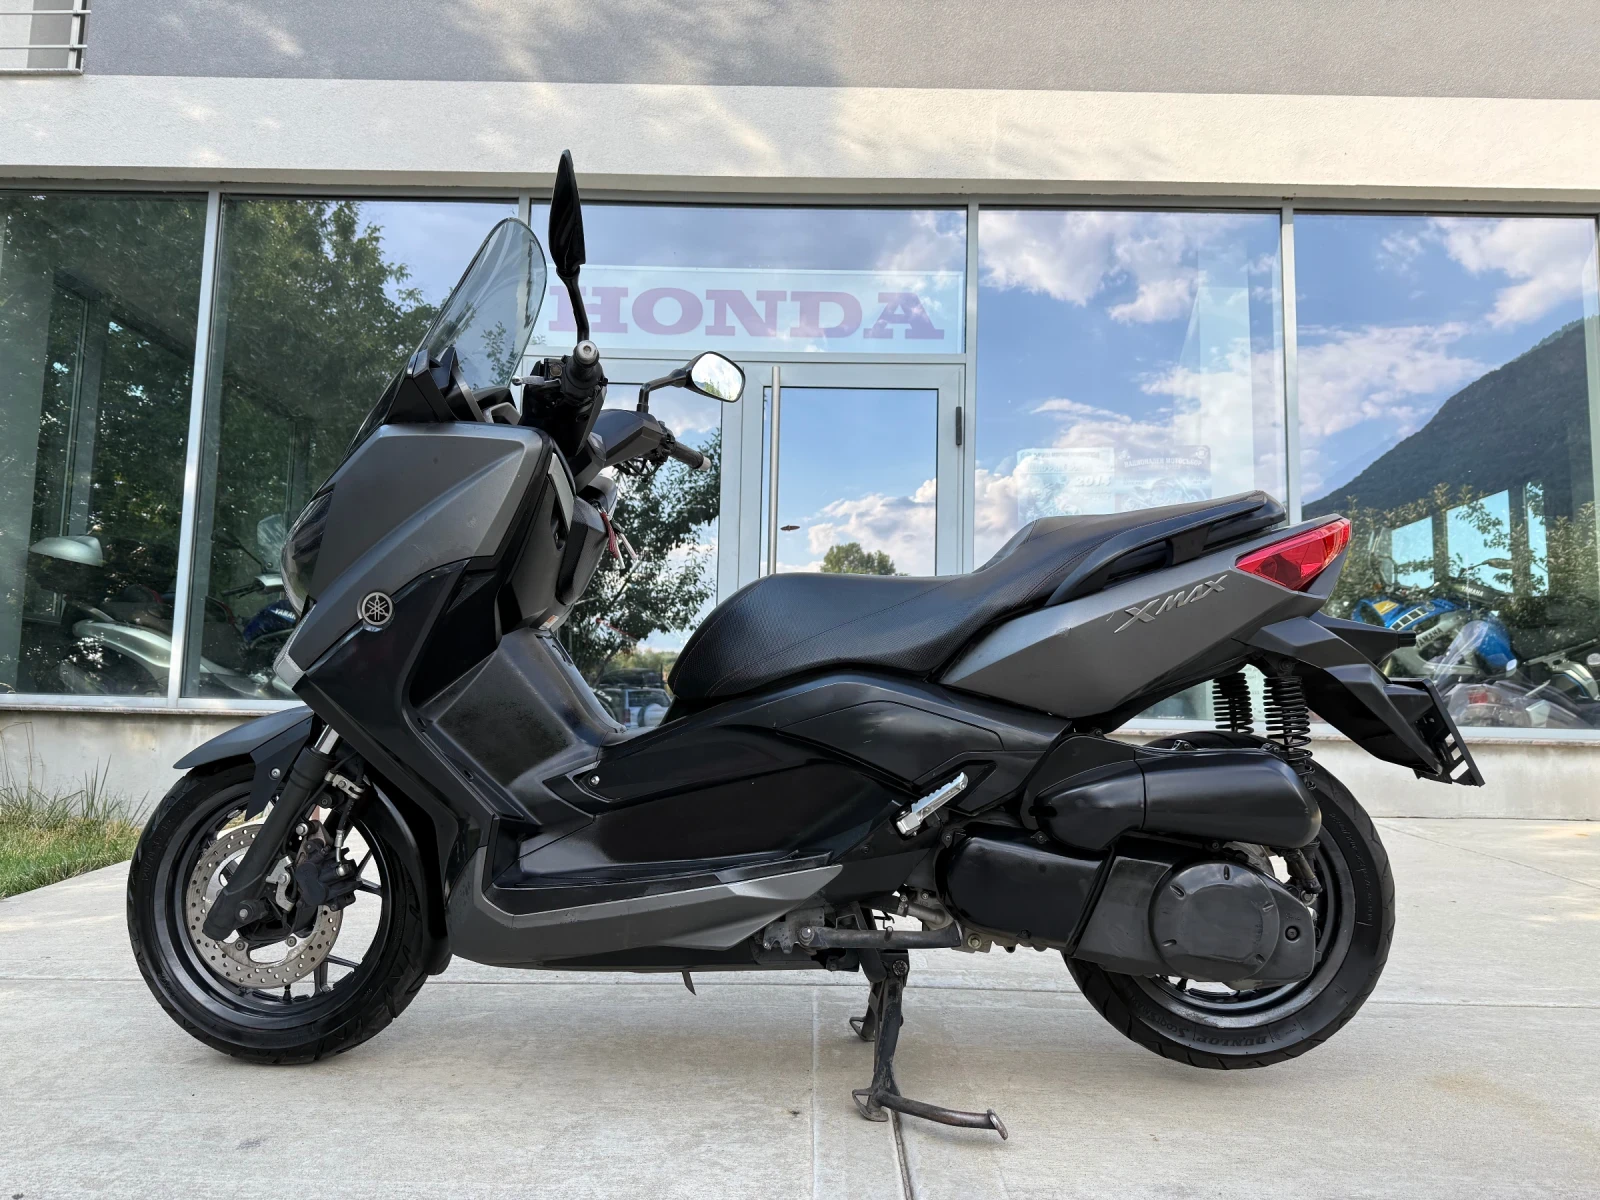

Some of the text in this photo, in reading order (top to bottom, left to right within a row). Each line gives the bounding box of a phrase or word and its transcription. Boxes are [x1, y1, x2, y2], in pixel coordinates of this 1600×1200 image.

[548, 286, 945, 340] HONDA
[1461, 585, 1484, 597] YAMAHA
[275, 607, 297, 620] YAMAH
[1197, 1035, 1268, 1047] DUNLOP
